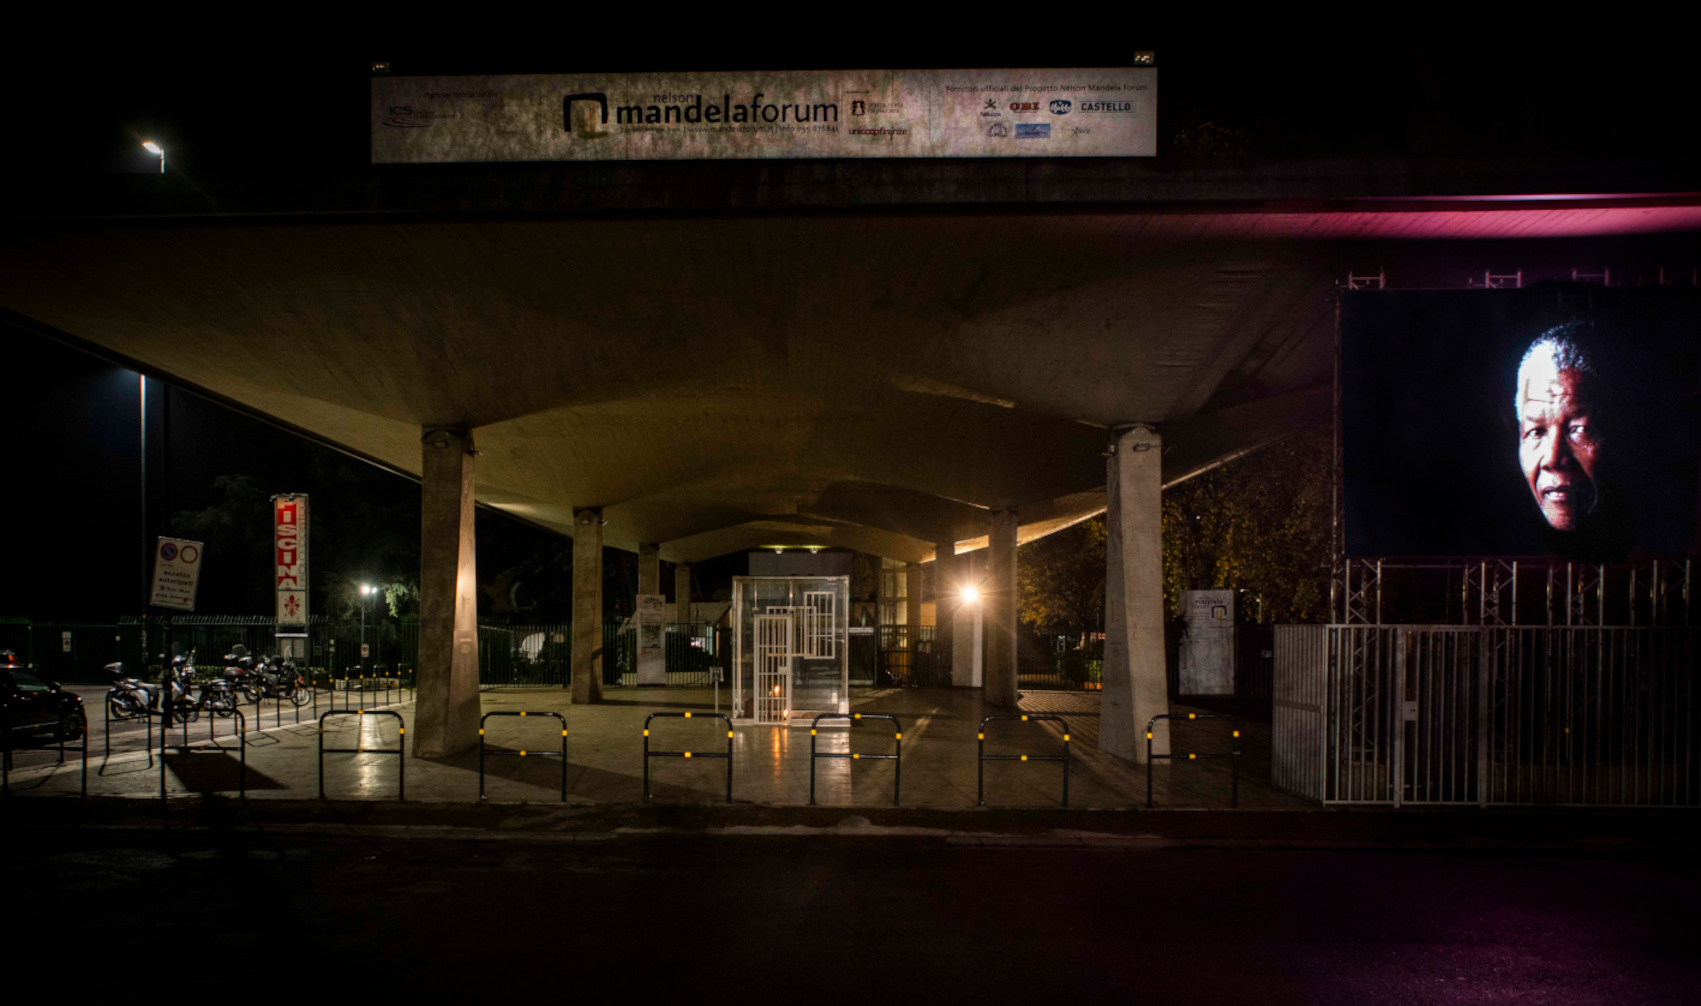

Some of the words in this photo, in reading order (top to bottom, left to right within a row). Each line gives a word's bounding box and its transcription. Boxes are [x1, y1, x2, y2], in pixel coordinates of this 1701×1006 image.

[1024, 84, 1058, 93] Progetto
[1088, 83, 1121, 91] Mandela
[1123, 83, 1148, 91] Forum
[653, 92, 695, 104] nelson
[389, 105, 413, 116] ICS
[1009, 102, 1039, 111] OBI
[1081, 102, 1131, 111] CASTELLO
